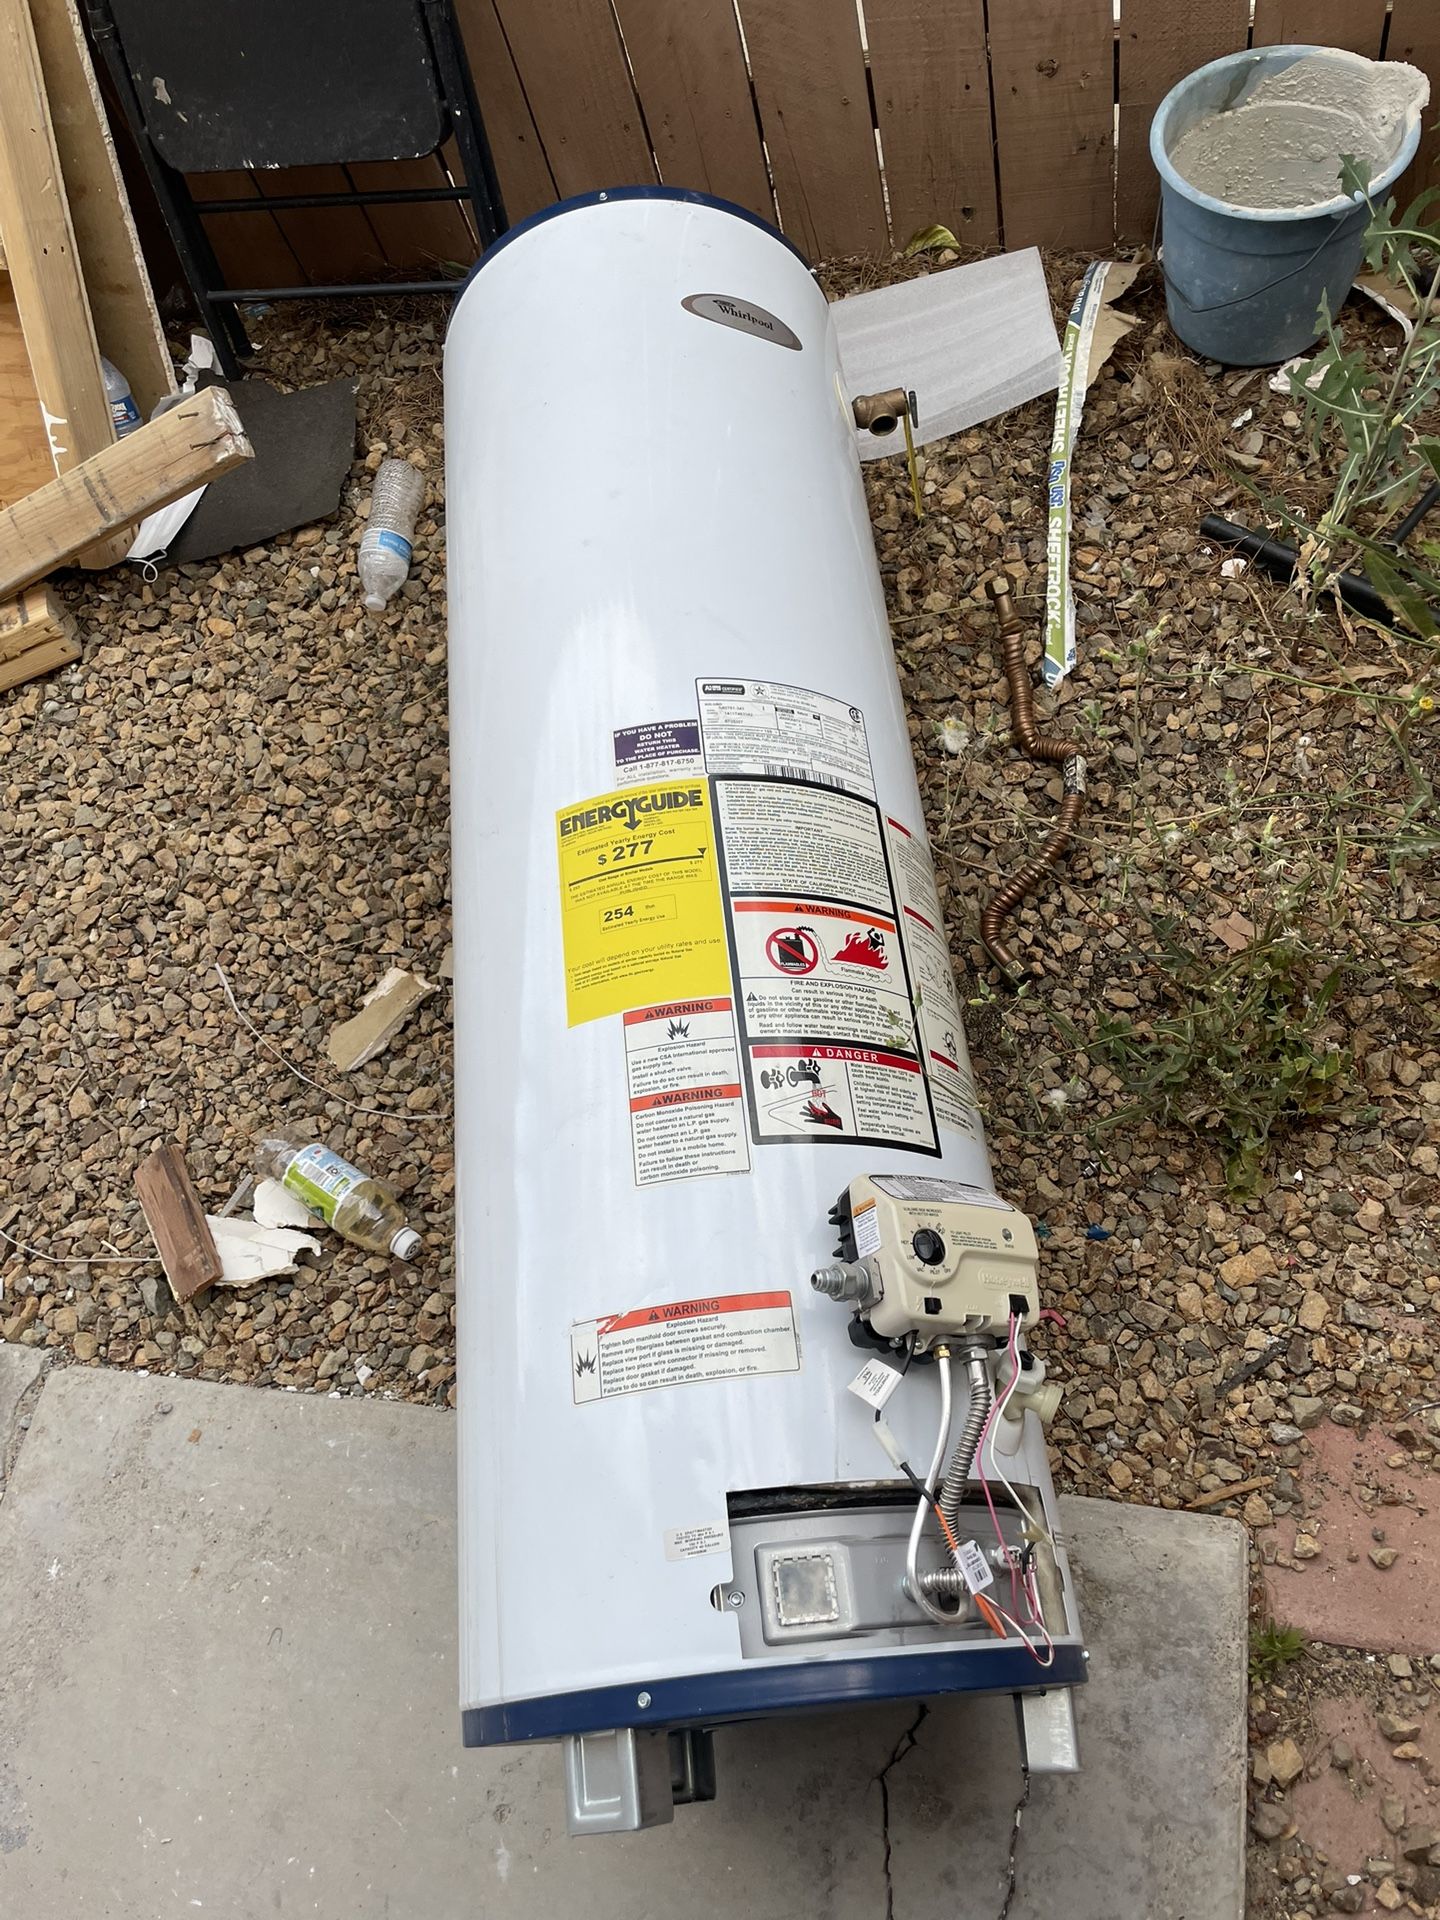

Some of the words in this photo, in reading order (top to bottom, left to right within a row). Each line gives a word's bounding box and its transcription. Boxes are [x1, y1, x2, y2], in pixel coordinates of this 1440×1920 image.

[719, 305, 773, 330] Whirlpool
[640, 758, 694, 770] 1-877-817-6750
[560, 790, 703, 837] ENERGYGUIDE
[577, 841, 608, 856] Estimated
[610, 836, 630, 849] Yearly
[633, 832, 657, 842] Energy
[598, 854, 607, 866] $
[612, 840, 654, 862] 277
[809, 881, 838, 890] CALIFORNIA
[840, 884, 856, 894] NOTICE
[604, 906, 634, 922] 254
[806, 905, 851, 918] WARNING
[602, 923, 624, 931] Estimated
[607, 952, 630, 962] depend
[641, 946, 655, 955] your
[841, 967, 865, 976] Flammable
[820, 982, 853, 990] EXPLOSION
[655, 1002, 713, 1016] WARNING
[658, 1044, 685, 1052] Explosion
[673, 1050, 708, 1058] International
[826, 1048, 878, 1063] DANGER
[662, 1089, 723, 1104] WARNING
[636, 1112, 655, 1120] Carbon
[657, 1107, 683, 1115] Monoxide
[685, 1103, 713, 1111] Poisoning
[656, 1116, 678, 1125] connect
[661, 1169, 688, 1177] monoxide
[690, 1165, 720, 1173] poisoning.
[663, 1300, 720, 1318] WARNING
[666, 1320, 696, 1328] Explosion
[601, 1341, 624, 1350] Tighten
[622, 1337, 635, 1345] both
[636, 1334, 661, 1342] manifold
[700, 1323, 727, 1332] securely.
[602, 1350, 623, 1358] Remove
[636, 1342, 664, 1351] fiberglass
[666, 1338, 690, 1346] between
[692, 1334, 712, 1343] gasket
[726, 1329, 762, 1338] combustion
[602, 1358, 624, 1367] Replace
[639, 1352, 651, 1360] port
[681, 1344, 705, 1352] missing
[715, 1340, 744, 1348] damaged.
